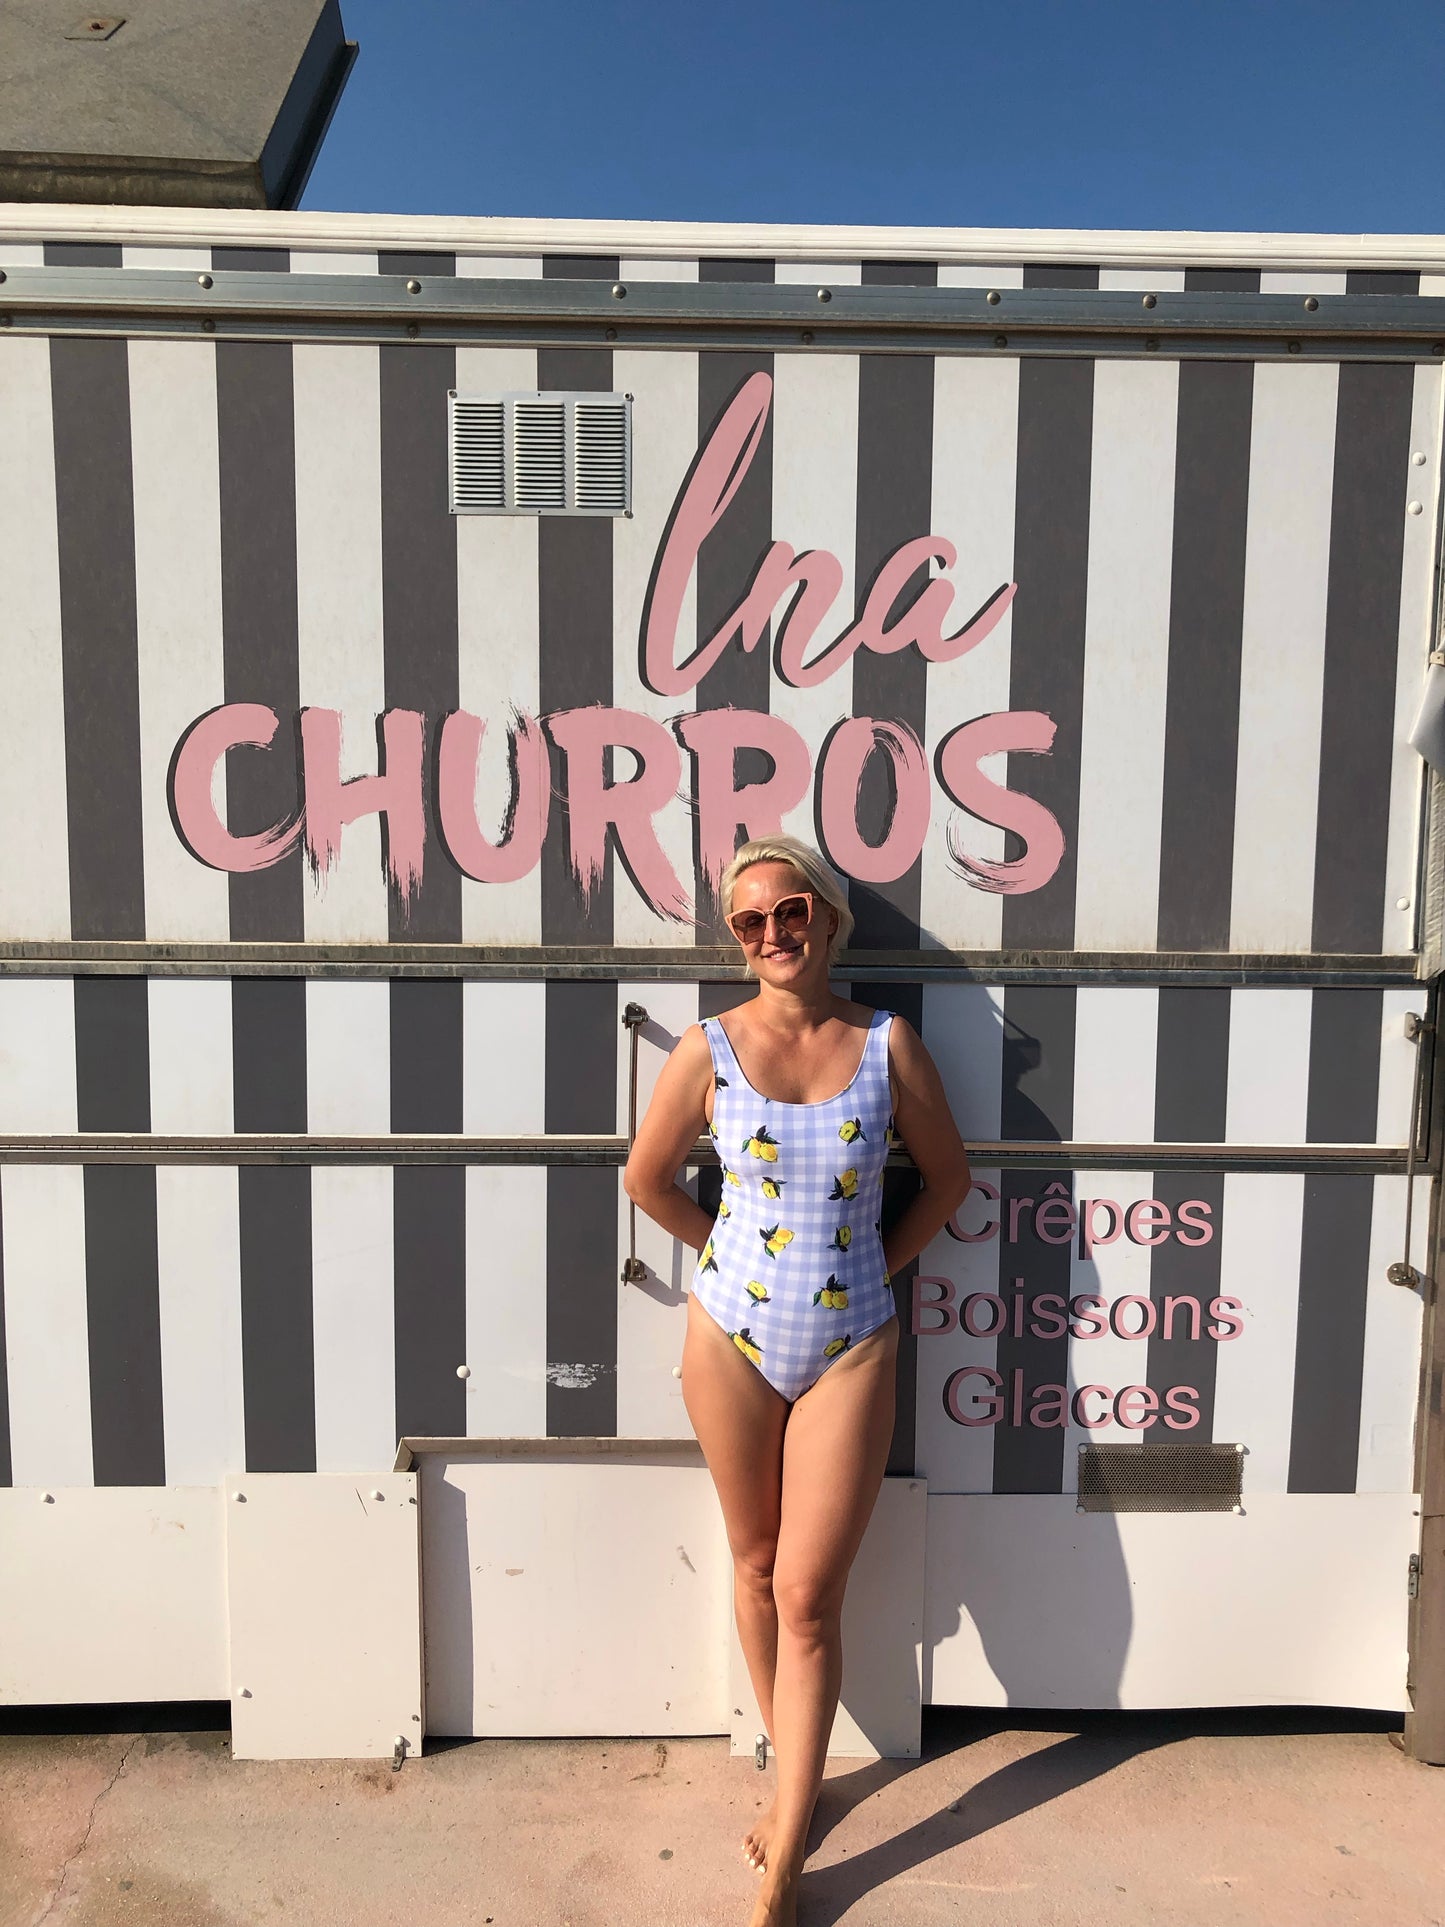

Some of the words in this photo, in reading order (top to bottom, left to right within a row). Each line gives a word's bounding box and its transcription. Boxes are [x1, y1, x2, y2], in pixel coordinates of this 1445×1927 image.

[166, 699, 1067, 928] CHURROS
[944, 1181, 1213, 1261] Crêpes
[908, 1275, 1245, 1341] Boissons
[942, 1366, 1201, 1430] Glaces
